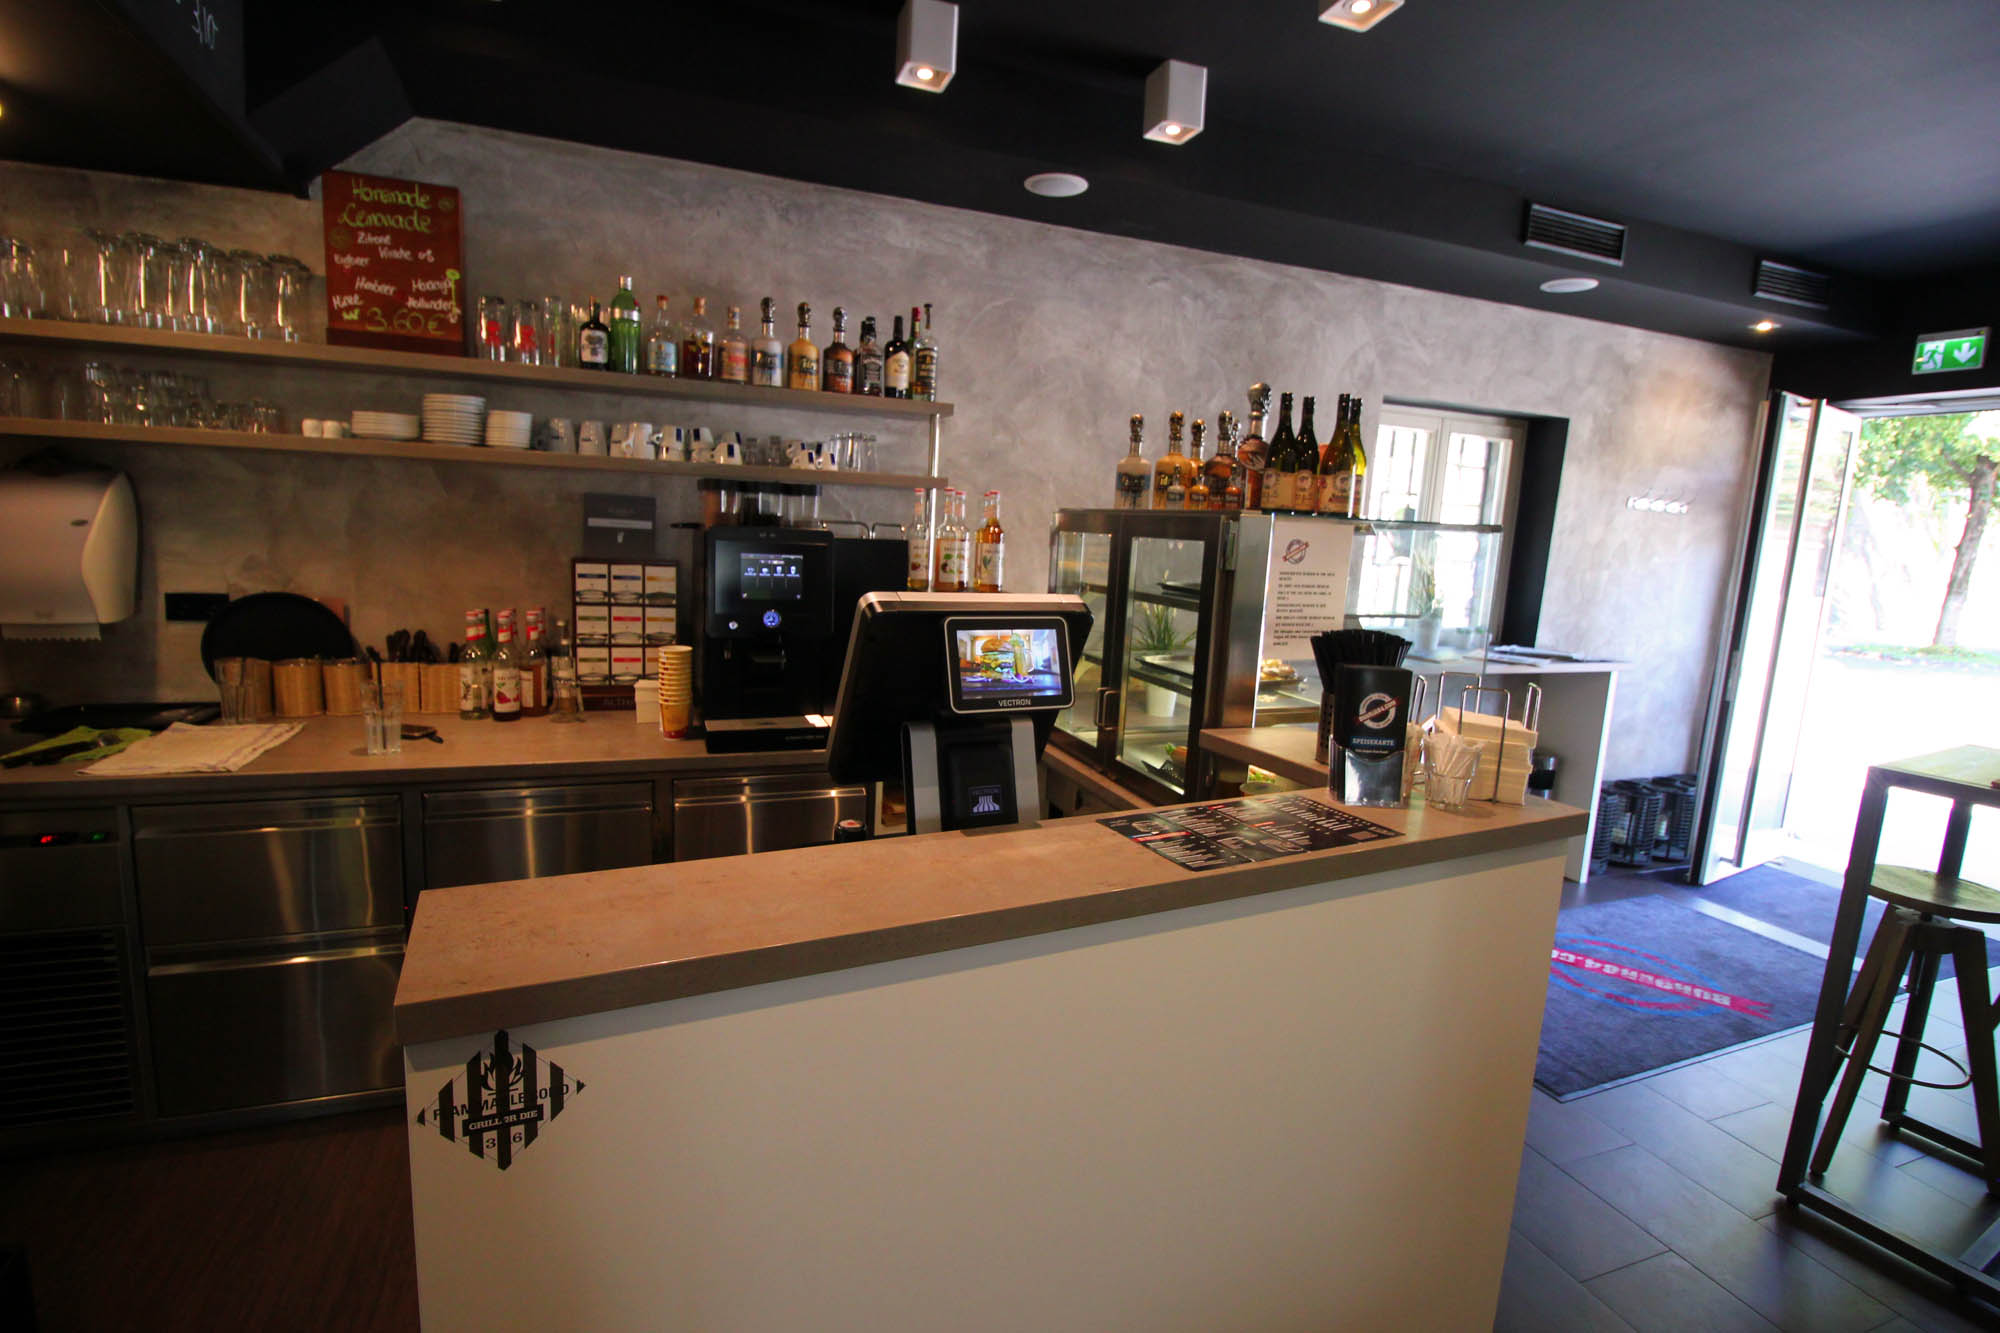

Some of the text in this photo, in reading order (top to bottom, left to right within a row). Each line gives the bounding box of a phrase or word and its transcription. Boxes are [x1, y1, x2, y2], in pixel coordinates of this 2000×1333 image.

[352, 177, 432, 209] Homemade
[998, 698, 1031, 707] VECTRON
[469, 1118, 503, 1130] GRILL
[520, 1110, 538, 1120] DIE
